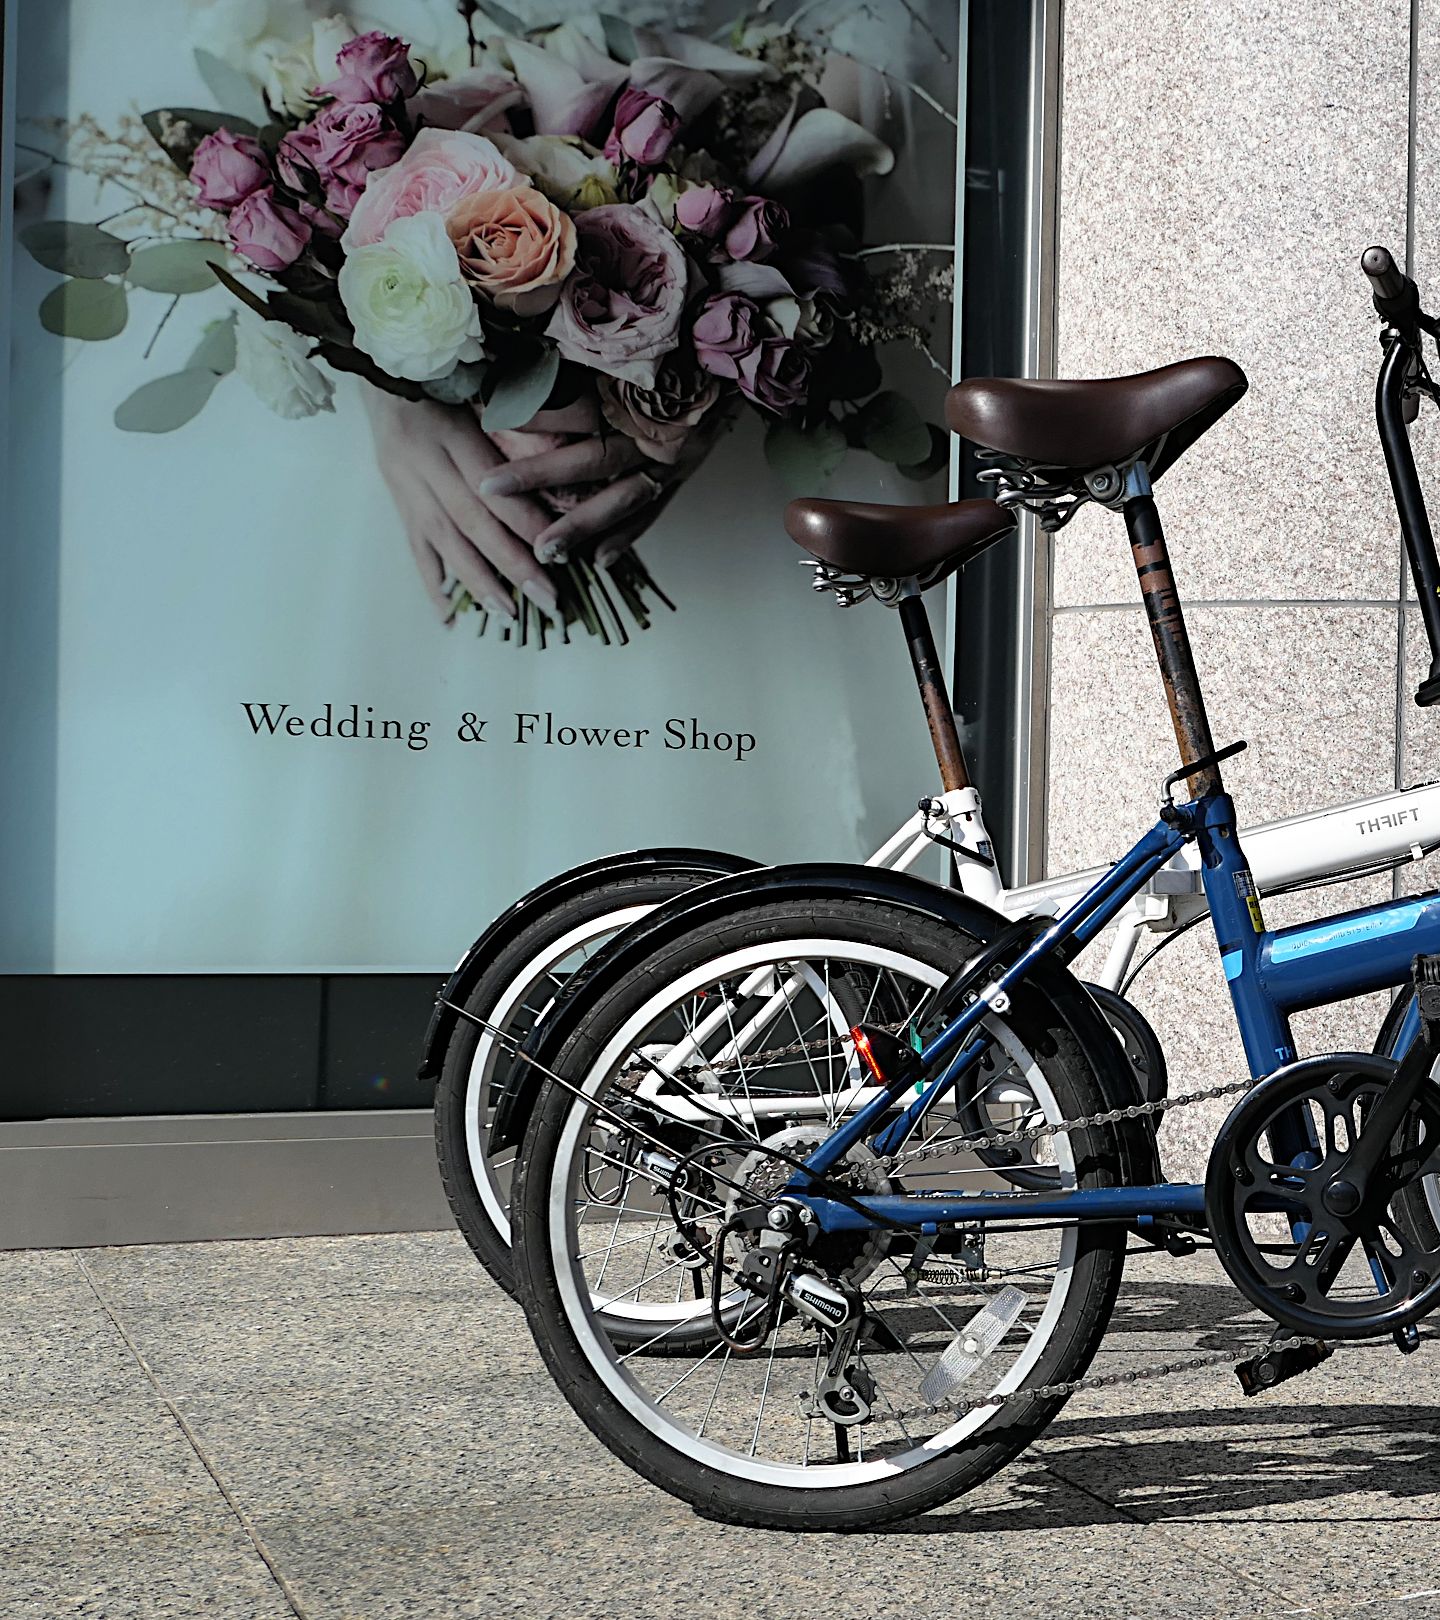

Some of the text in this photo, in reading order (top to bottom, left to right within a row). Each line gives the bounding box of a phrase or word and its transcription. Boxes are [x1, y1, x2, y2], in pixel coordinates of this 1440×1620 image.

[240, 703, 755, 761] Wedding & Flower Shop
[1355, 807, 1419, 835] THRIFT
[803, 1292, 842, 1318] SHIMANO
